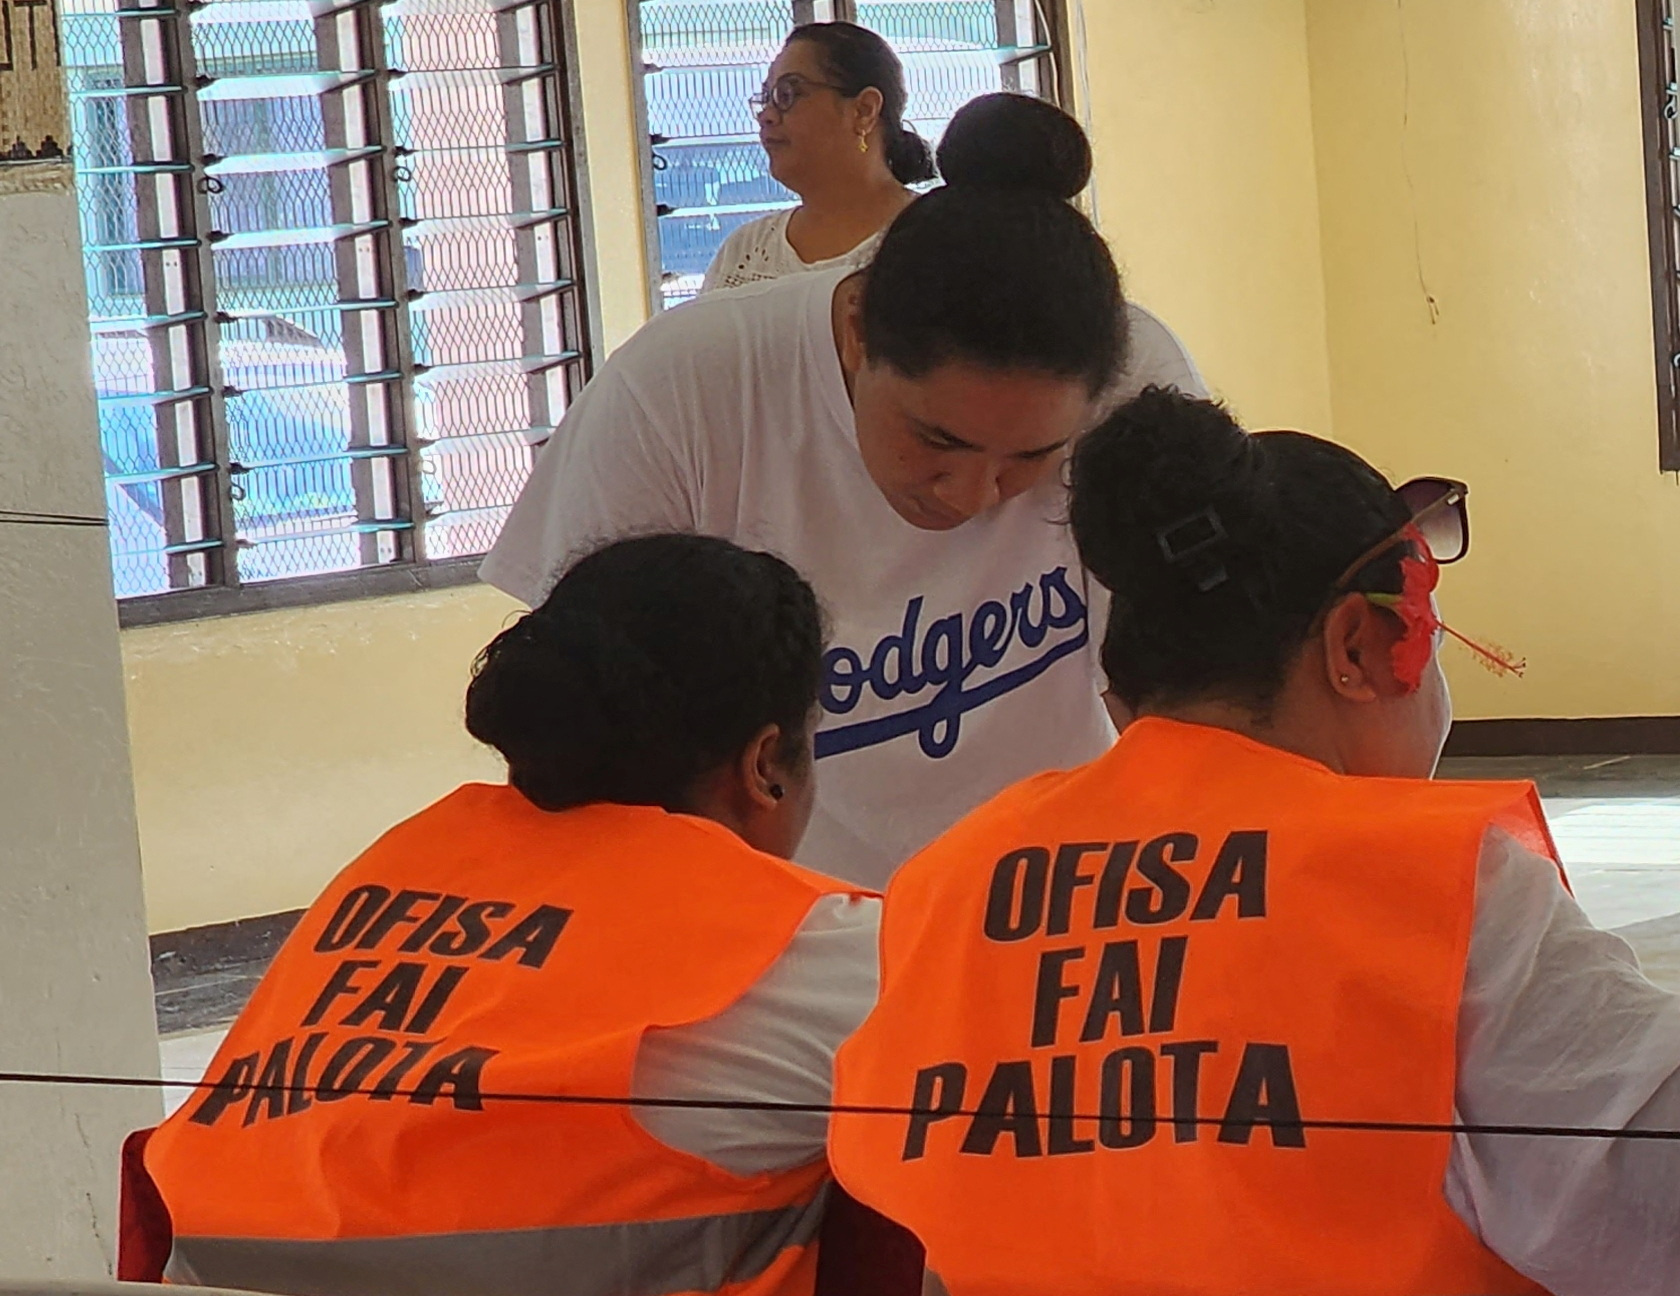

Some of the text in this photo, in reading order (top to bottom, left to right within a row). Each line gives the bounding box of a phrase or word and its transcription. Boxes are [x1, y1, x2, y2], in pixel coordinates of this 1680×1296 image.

[818, 565, 1088, 759] odgers
[313, 883, 575, 970] OFISA
[983, 829, 1269, 943] OFISA
[300, 958, 469, 1035] FAI
[1030, 934, 1188, 1049] FAI
[188, 1031, 500, 1130] PALOTA
[901, 1040, 1308, 1163] PALOTA
